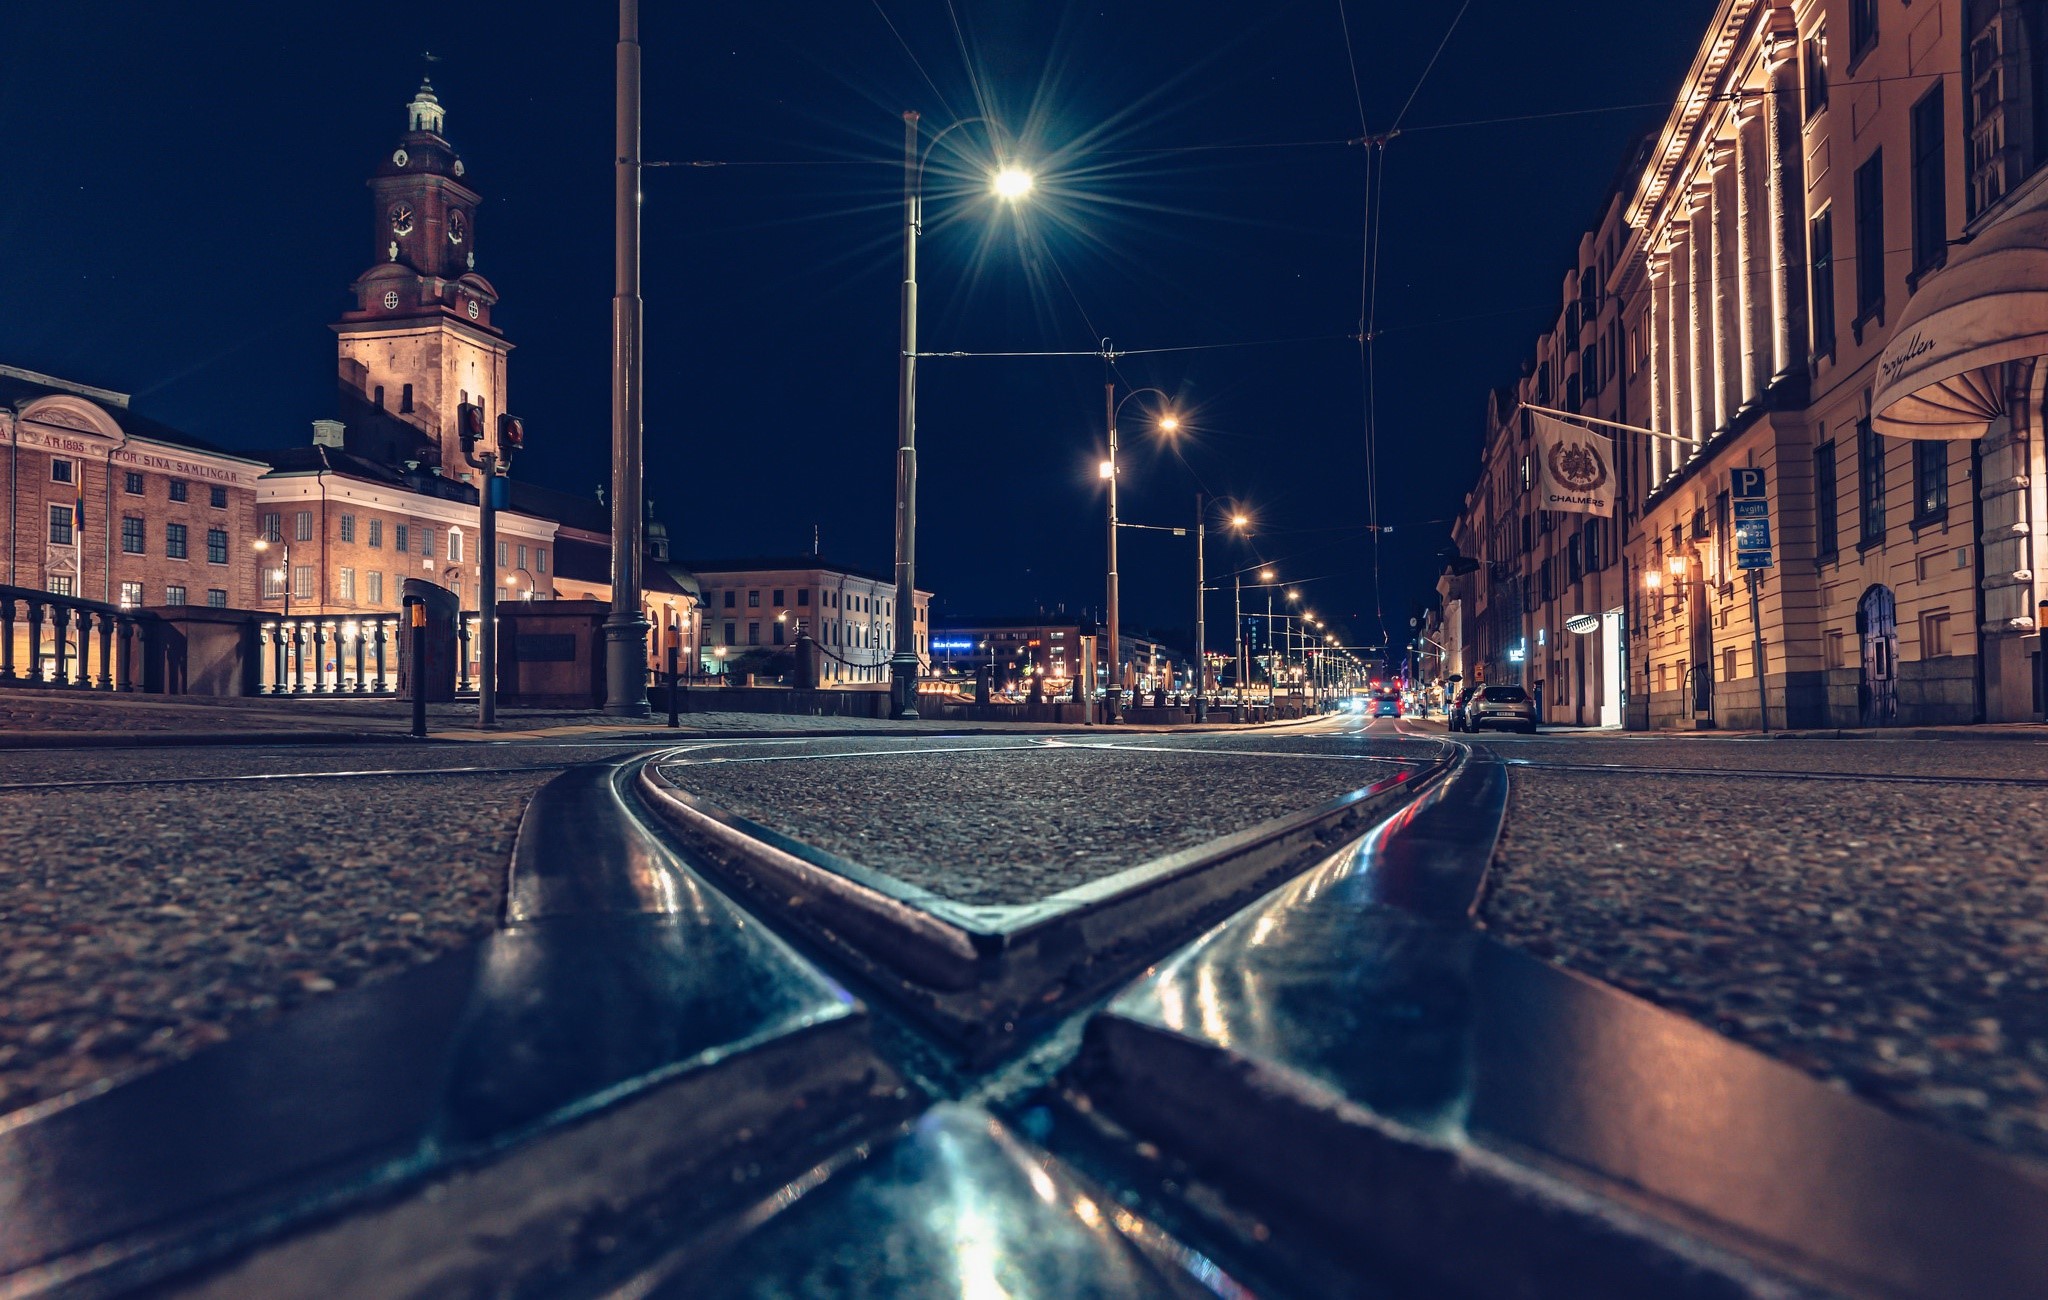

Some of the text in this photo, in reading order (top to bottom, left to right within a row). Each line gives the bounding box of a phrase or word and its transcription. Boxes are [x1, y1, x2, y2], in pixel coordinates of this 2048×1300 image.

[63, 440, 85, 452] 1895
[144, 455, 170, 470] SINA
[177, 463, 237, 482] SAMLINGAR
[1742, 471, 1758, 495] P
[1550, 495, 1604, 507] CHALMERS
[1740, 504, 1764, 515] Avgift
[1755, 530, 1764, 538] 22
